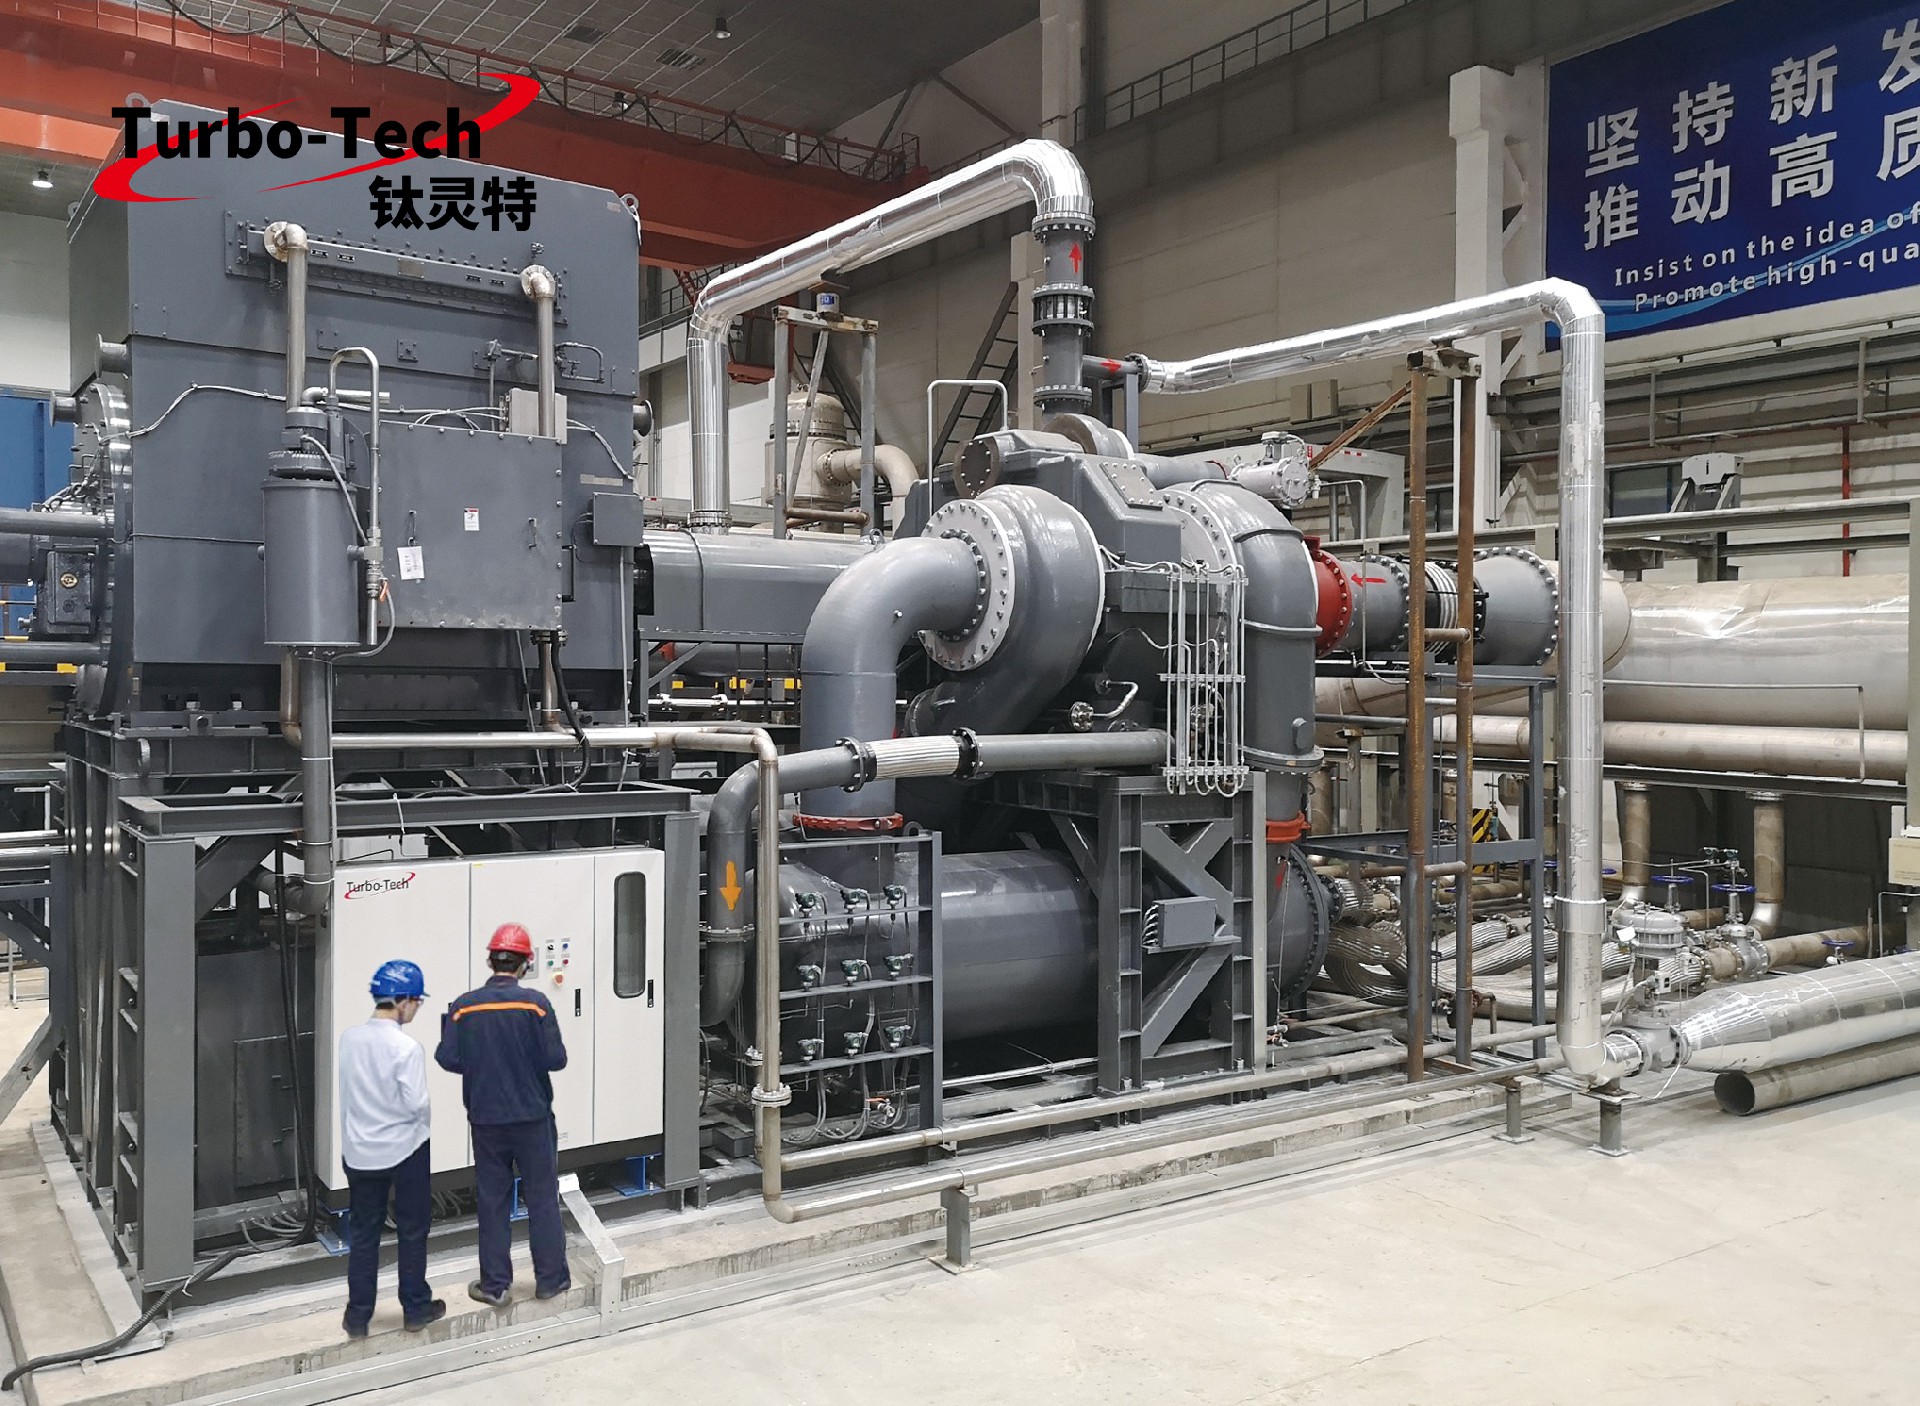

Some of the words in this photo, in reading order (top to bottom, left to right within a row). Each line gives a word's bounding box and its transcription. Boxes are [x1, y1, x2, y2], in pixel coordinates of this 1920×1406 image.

[1615, 254, 1692, 286] Insist
[1702, 247, 1735, 268] on
[1746, 235, 1795, 259] the
[1805, 220, 1874, 247] idea
[1886, 200, 1920, 229] of
[1635, 275, 1755, 312] Promote
[346, 877, 409, 893] Turbo-Tech
